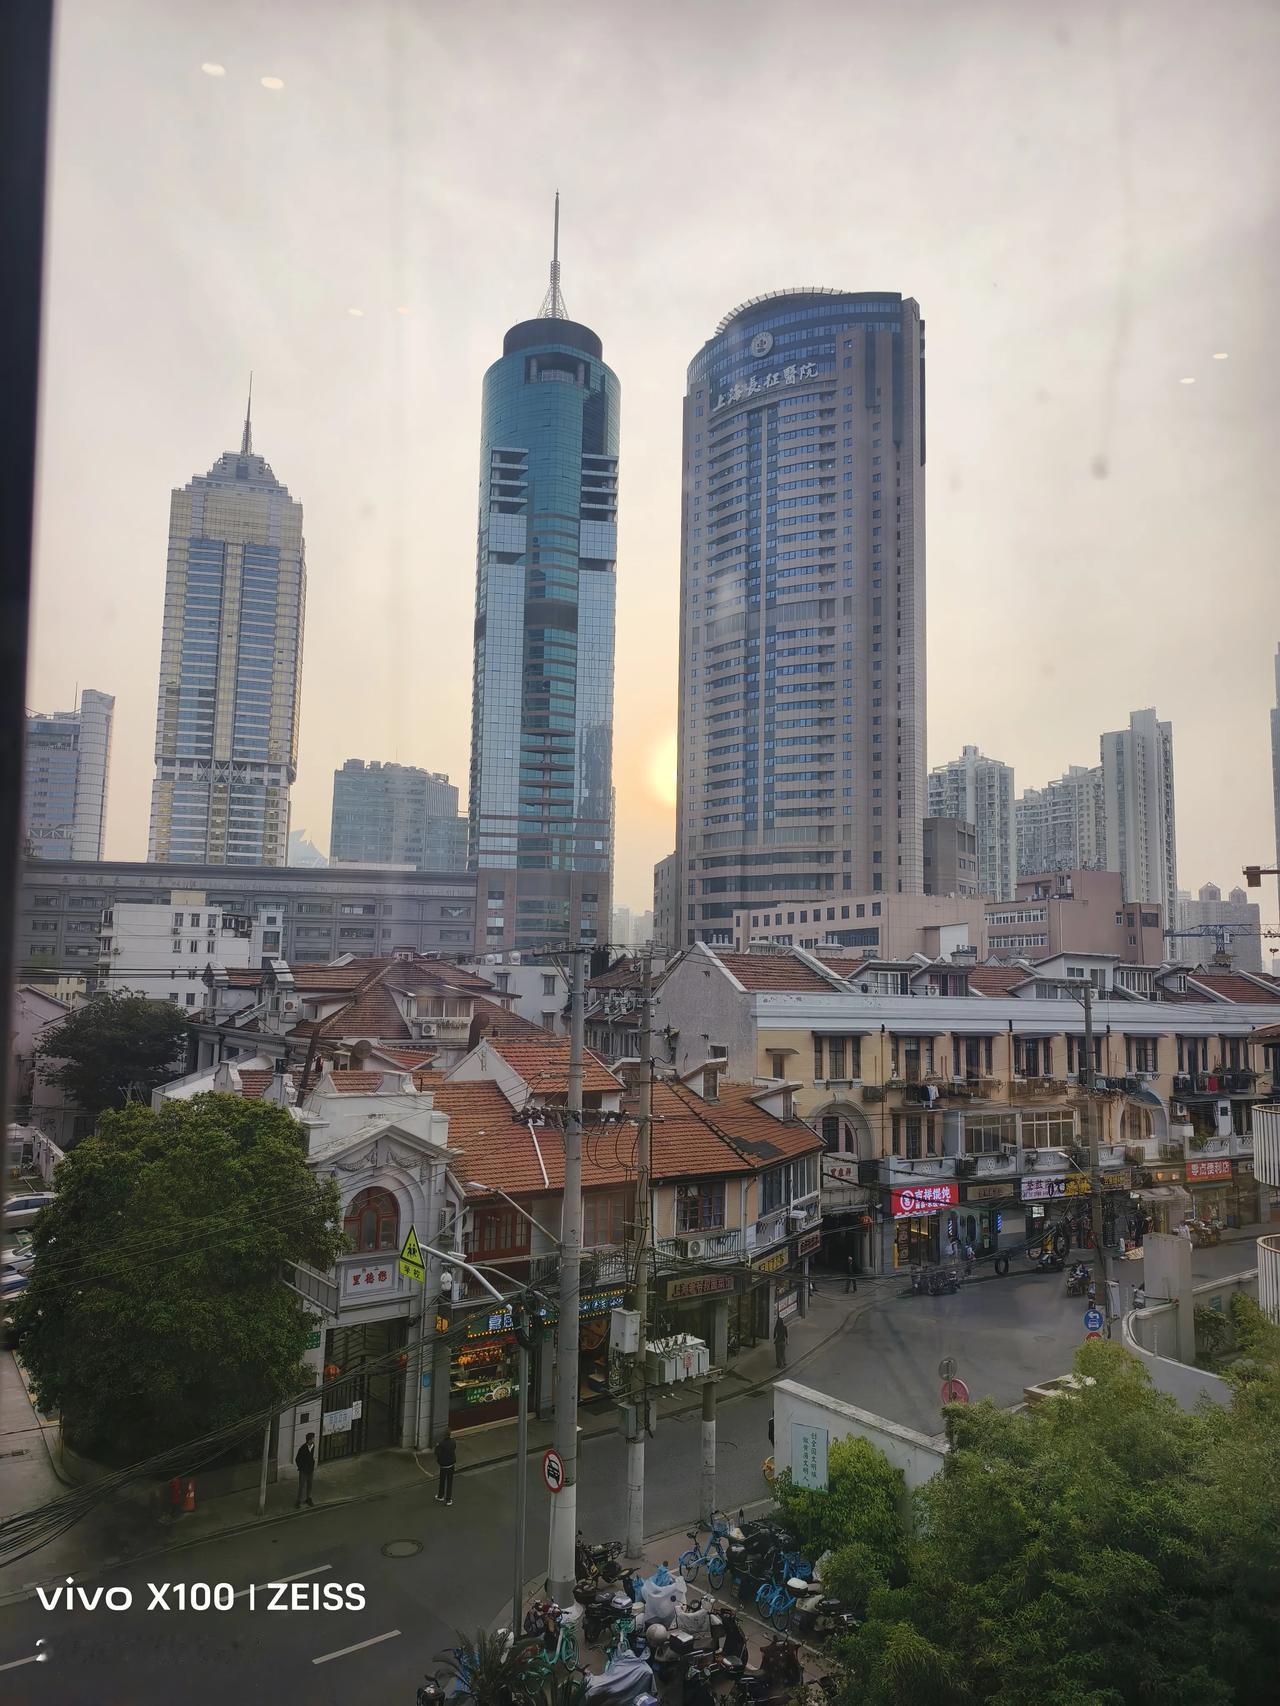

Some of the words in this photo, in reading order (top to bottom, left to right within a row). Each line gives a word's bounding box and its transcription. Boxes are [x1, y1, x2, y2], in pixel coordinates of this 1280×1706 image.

[1191, 1160, 1230, 1176] 零点便利店
[914, 1186, 951, 1201] 吉祥馄饨
[404, 1264, 421, 1280] 学校
